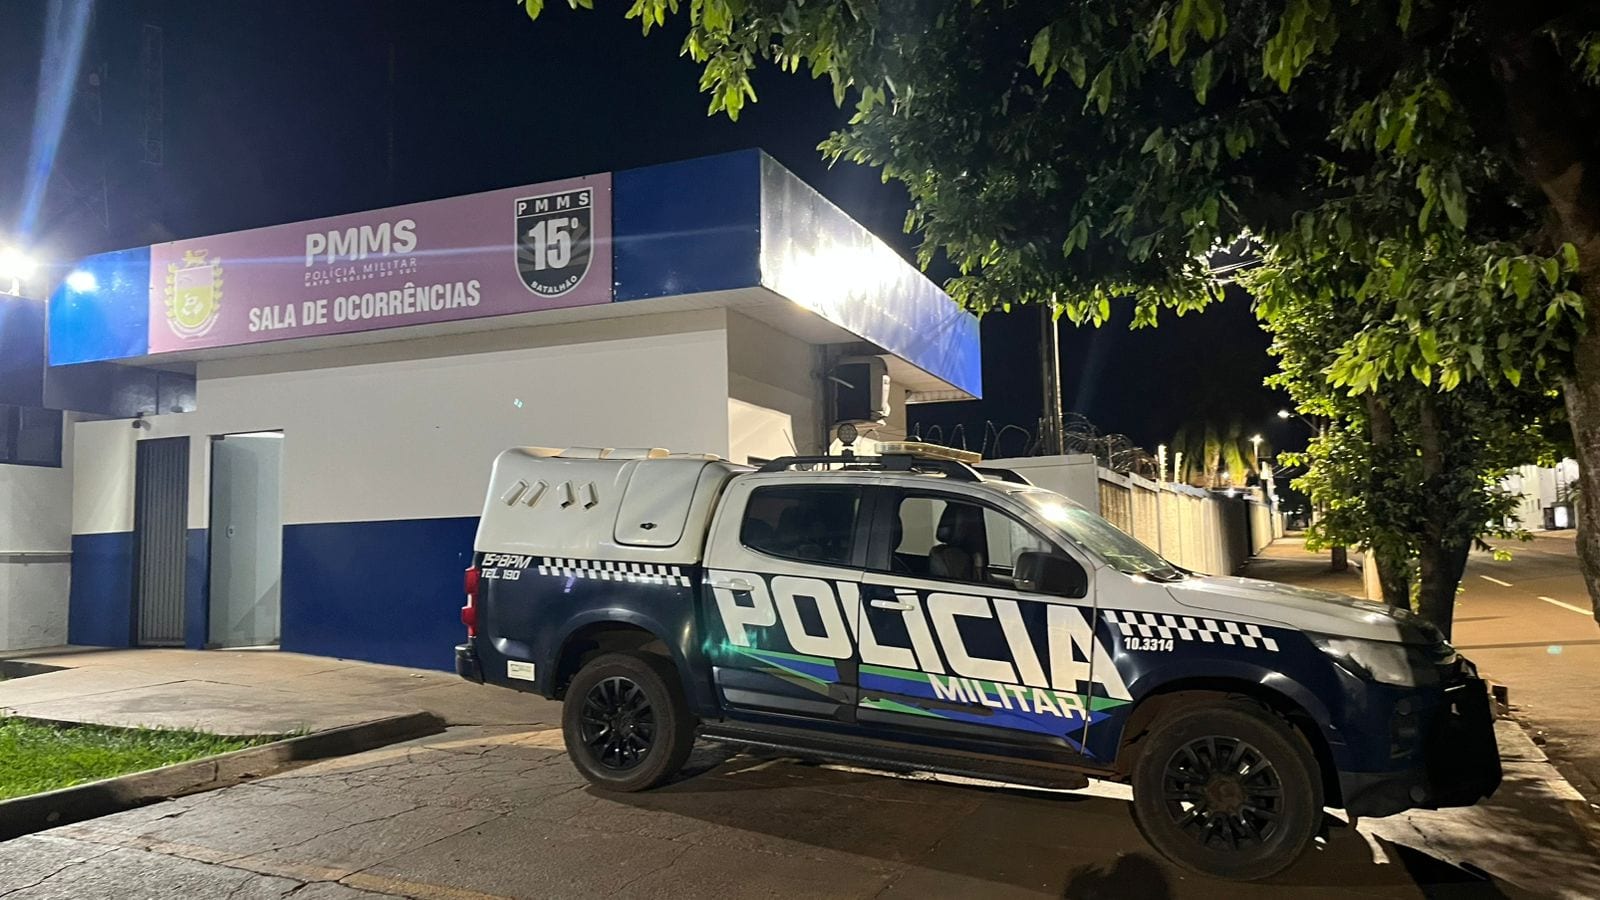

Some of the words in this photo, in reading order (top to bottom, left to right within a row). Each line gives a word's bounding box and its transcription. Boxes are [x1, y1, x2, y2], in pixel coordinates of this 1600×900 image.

[305, 219, 417, 268] PMMS
[362, 257, 417, 273] MILITAR
[530, 275, 578, 294] BATALHÃO
[248, 303, 297, 332] SALA
[302, 299, 328, 326] DE
[333, 280, 481, 322] OCORRÊNCIAS
[502, 569, 521, 580] 190
[1124, 637, 1174, 652] 10.3314
[927, 673, 1092, 722] MILITAR
